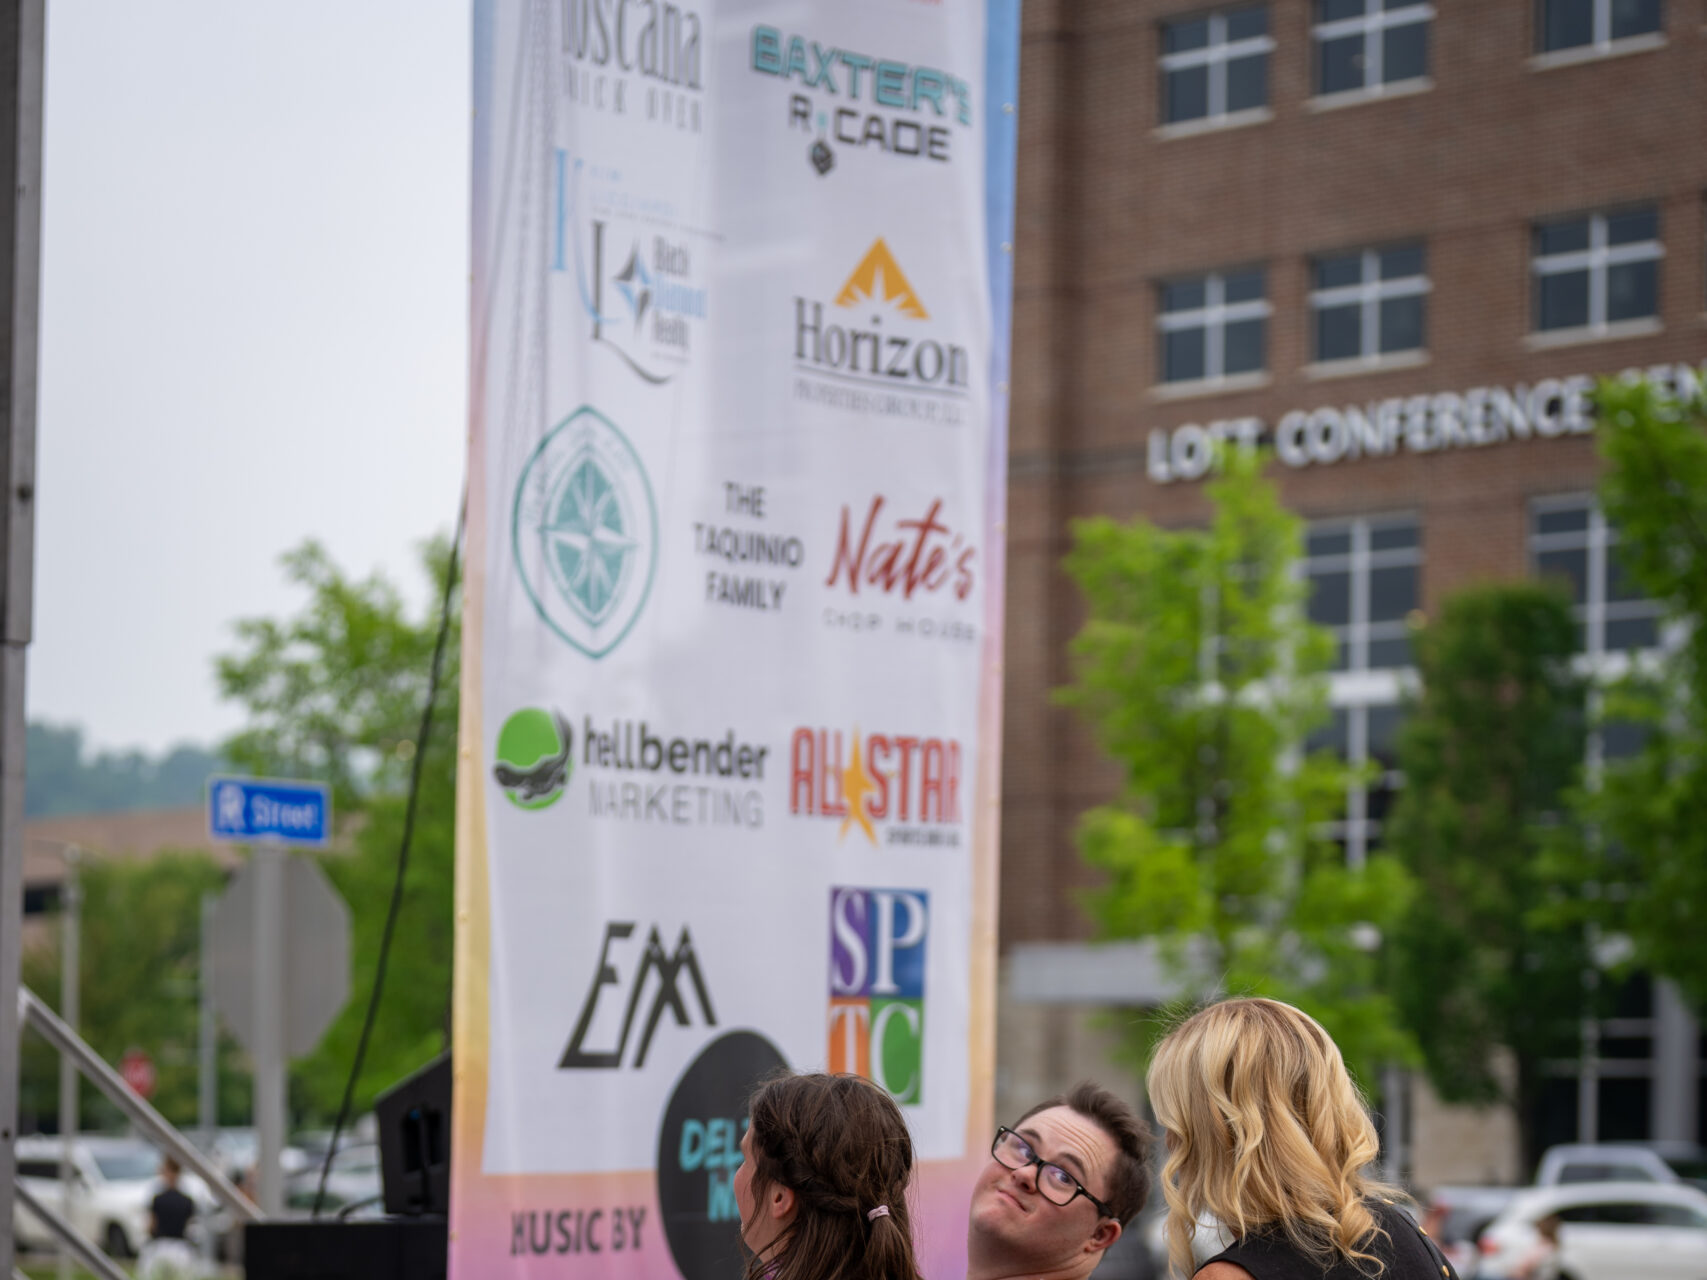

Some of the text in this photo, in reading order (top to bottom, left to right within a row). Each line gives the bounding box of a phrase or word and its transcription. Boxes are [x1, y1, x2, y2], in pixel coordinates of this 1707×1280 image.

[752, 24, 970, 126] BAXTER'S
[794, 295, 969, 387] Horizon
[1276, 373, 1597, 468] CONFERENCE
[724, 480, 767, 519] THE
[692, 521, 804, 569] TAQUINIO
[824, 494, 976, 601] Nate's
[704, 570, 786, 612] FAMILY
[583, 714, 768, 780] hellbender
[588, 778, 765, 829] MARKETING
[511, 1205, 647, 1257] MUSIC BY
